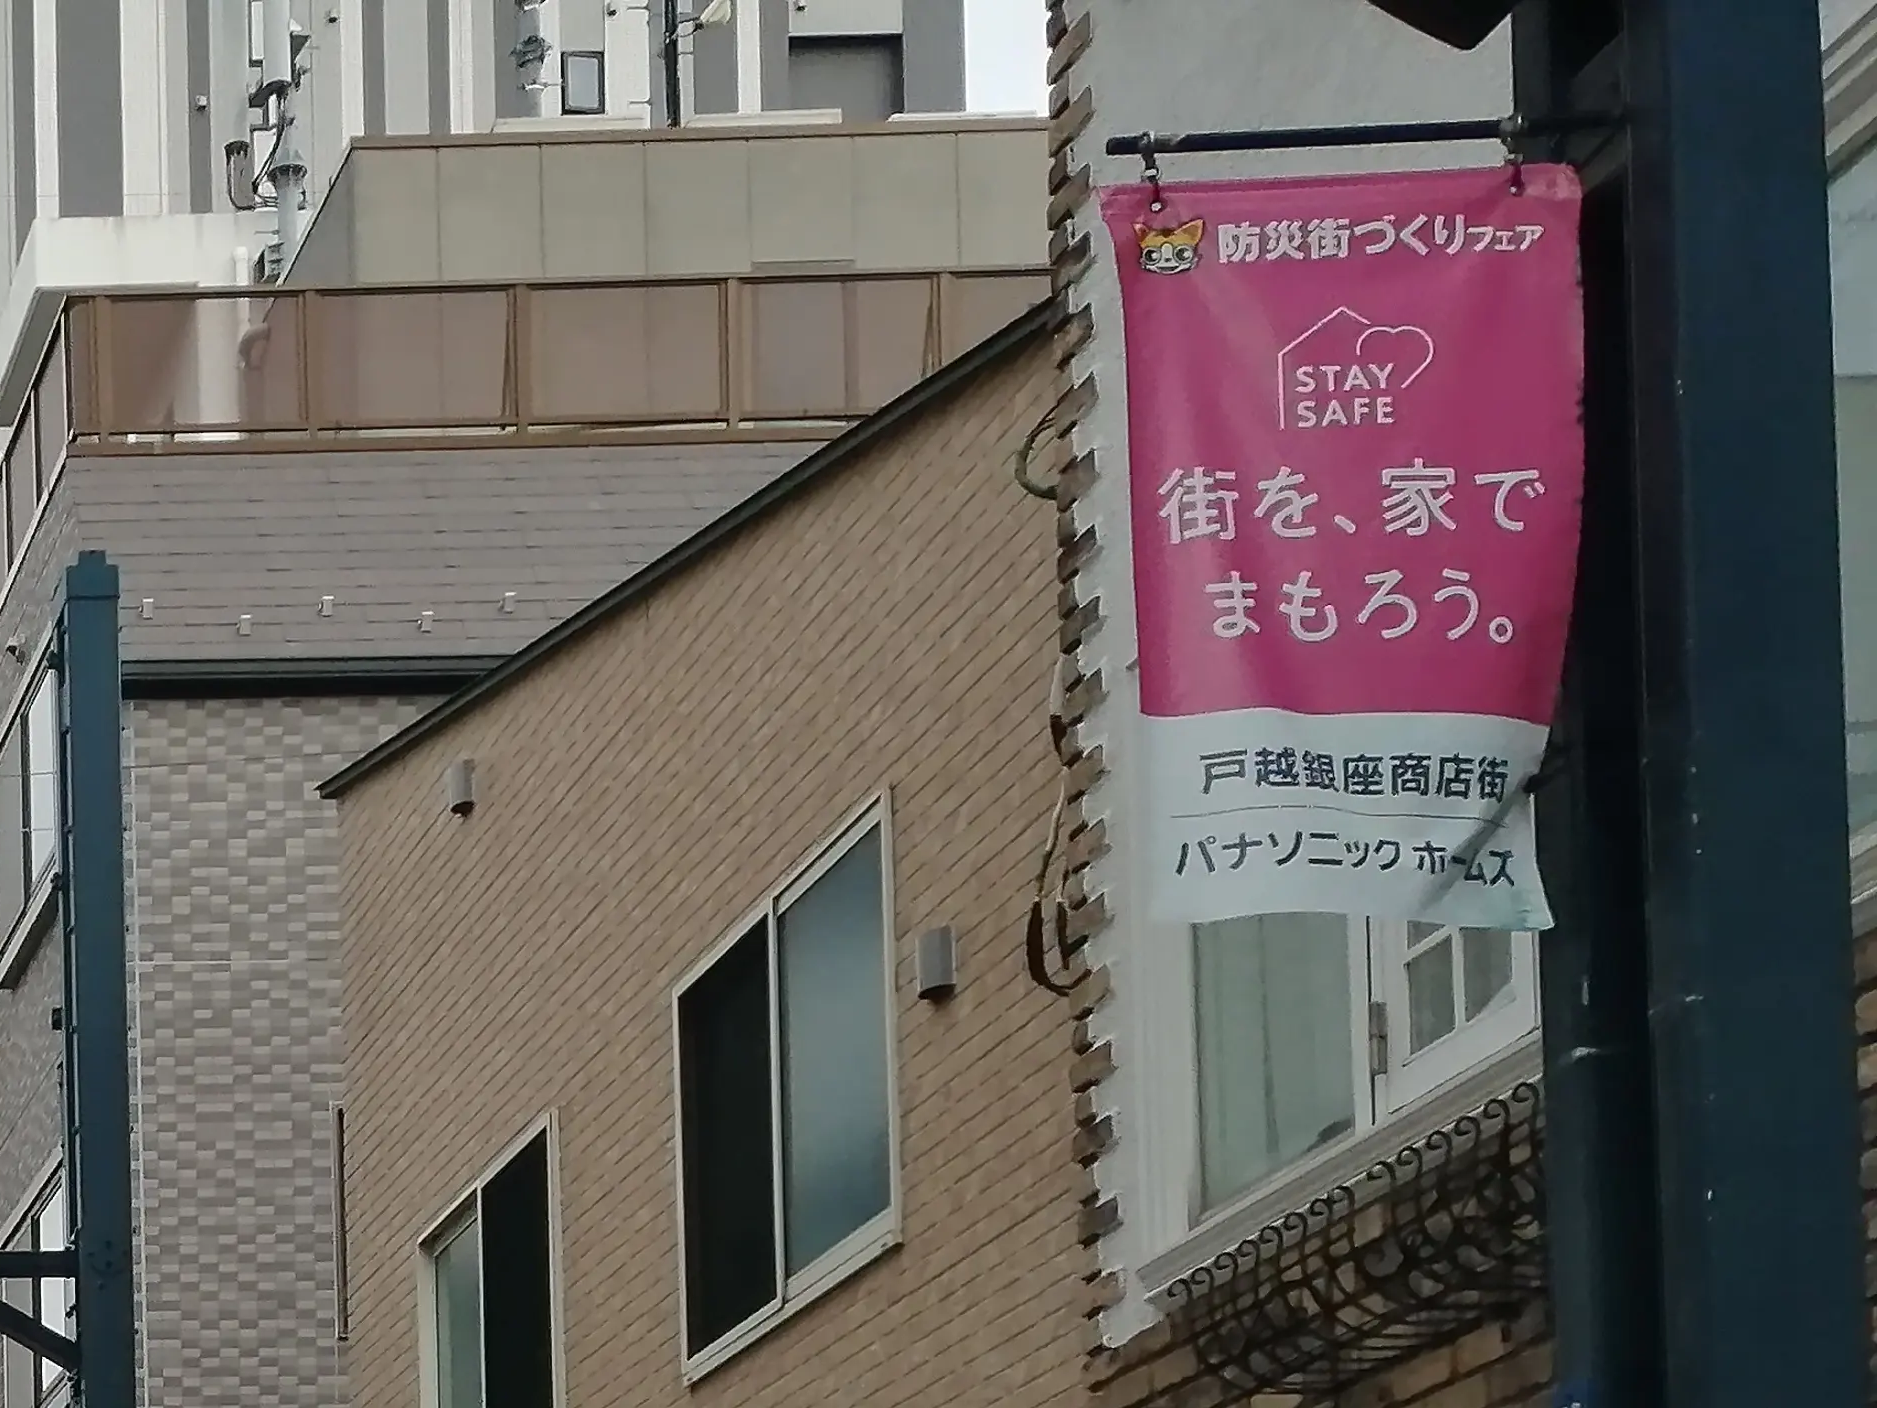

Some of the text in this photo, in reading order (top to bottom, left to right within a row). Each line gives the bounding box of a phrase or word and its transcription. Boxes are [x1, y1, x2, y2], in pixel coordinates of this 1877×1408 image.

[1216, 216, 1545, 265] 防災街づくりフェア
[1294, 363, 1392, 393] STAY
[1297, 396, 1396, 427] SAFE
[1158, 457, 1547, 545] 街を、家で
[1204, 568, 1515, 645] まもろう。
[1199, 746, 1511, 801] 戸越銀座商店街
[1175, 829, 1516, 888] パナソニック ホームズ
